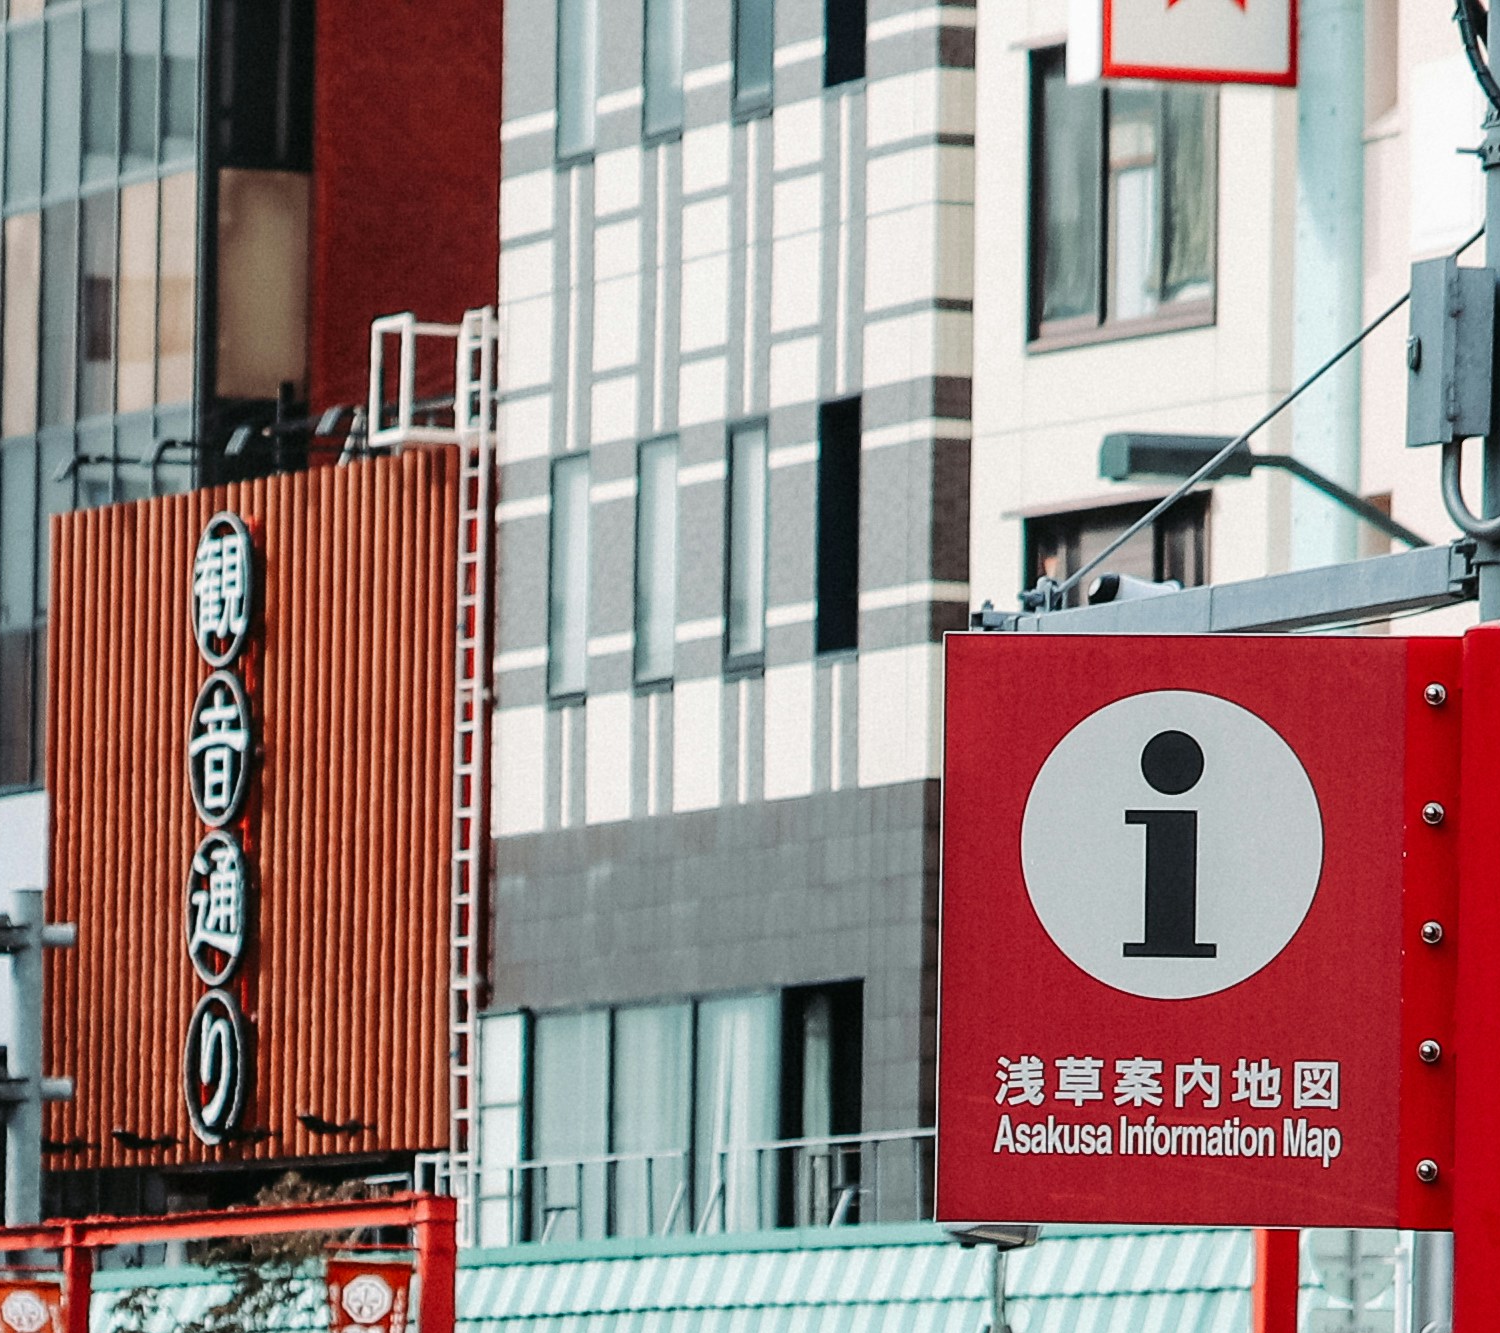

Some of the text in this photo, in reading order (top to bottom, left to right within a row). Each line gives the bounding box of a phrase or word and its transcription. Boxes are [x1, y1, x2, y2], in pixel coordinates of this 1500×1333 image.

[189, 517, 248, 1128] 観音通り
[994, 1055, 1341, 1110] 浅草案内地図
[994, 1114, 1342, 1168] Asakusa Information Map
